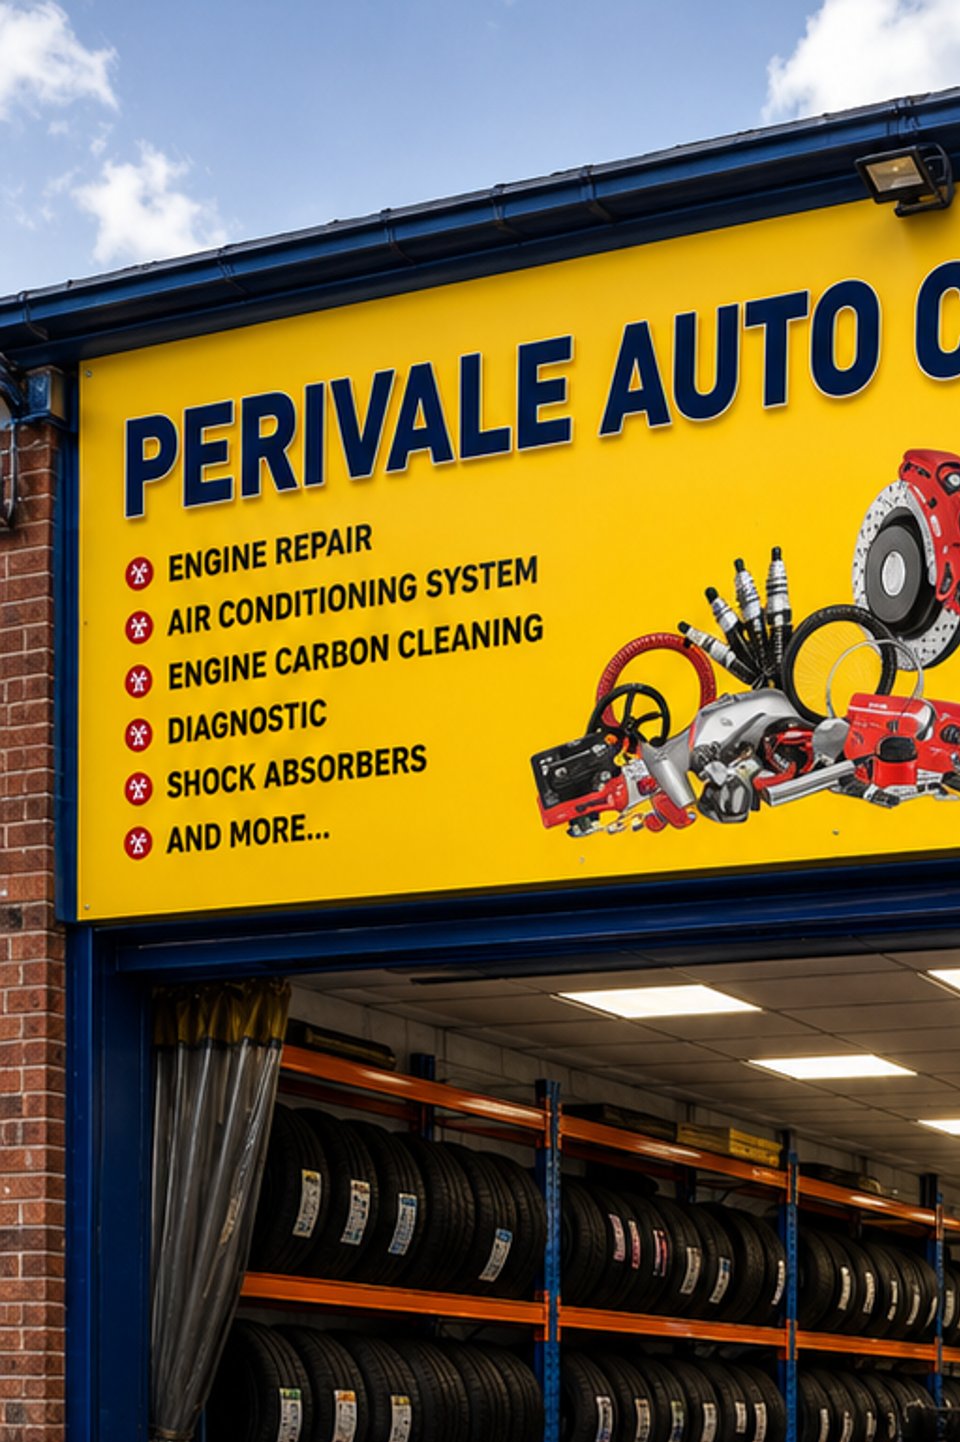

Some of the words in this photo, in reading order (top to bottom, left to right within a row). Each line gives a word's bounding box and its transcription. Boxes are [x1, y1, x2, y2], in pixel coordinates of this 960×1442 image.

[124, 335, 573, 519] PERIVALE
[598, 279, 881, 436] AUTO
[168, 540, 267, 582] ENGINE
[275, 523, 373, 565] REPAIR
[167, 604, 211, 637] AIR
[218, 573, 417, 628] CONDITIONING
[426, 555, 538, 598] SYSTEM
[168, 650, 267, 690] ENGINE
[275, 633, 389, 676] CARBON
[398, 613, 544, 659] CLEANING
[168, 698, 327, 745] DIAGNOSTIC
[166, 762, 256, 799] SHOCK
[263, 744, 427, 789] ABSORBERS
[166, 822, 222, 854] AND
[230, 813, 331, 848] MORE...
